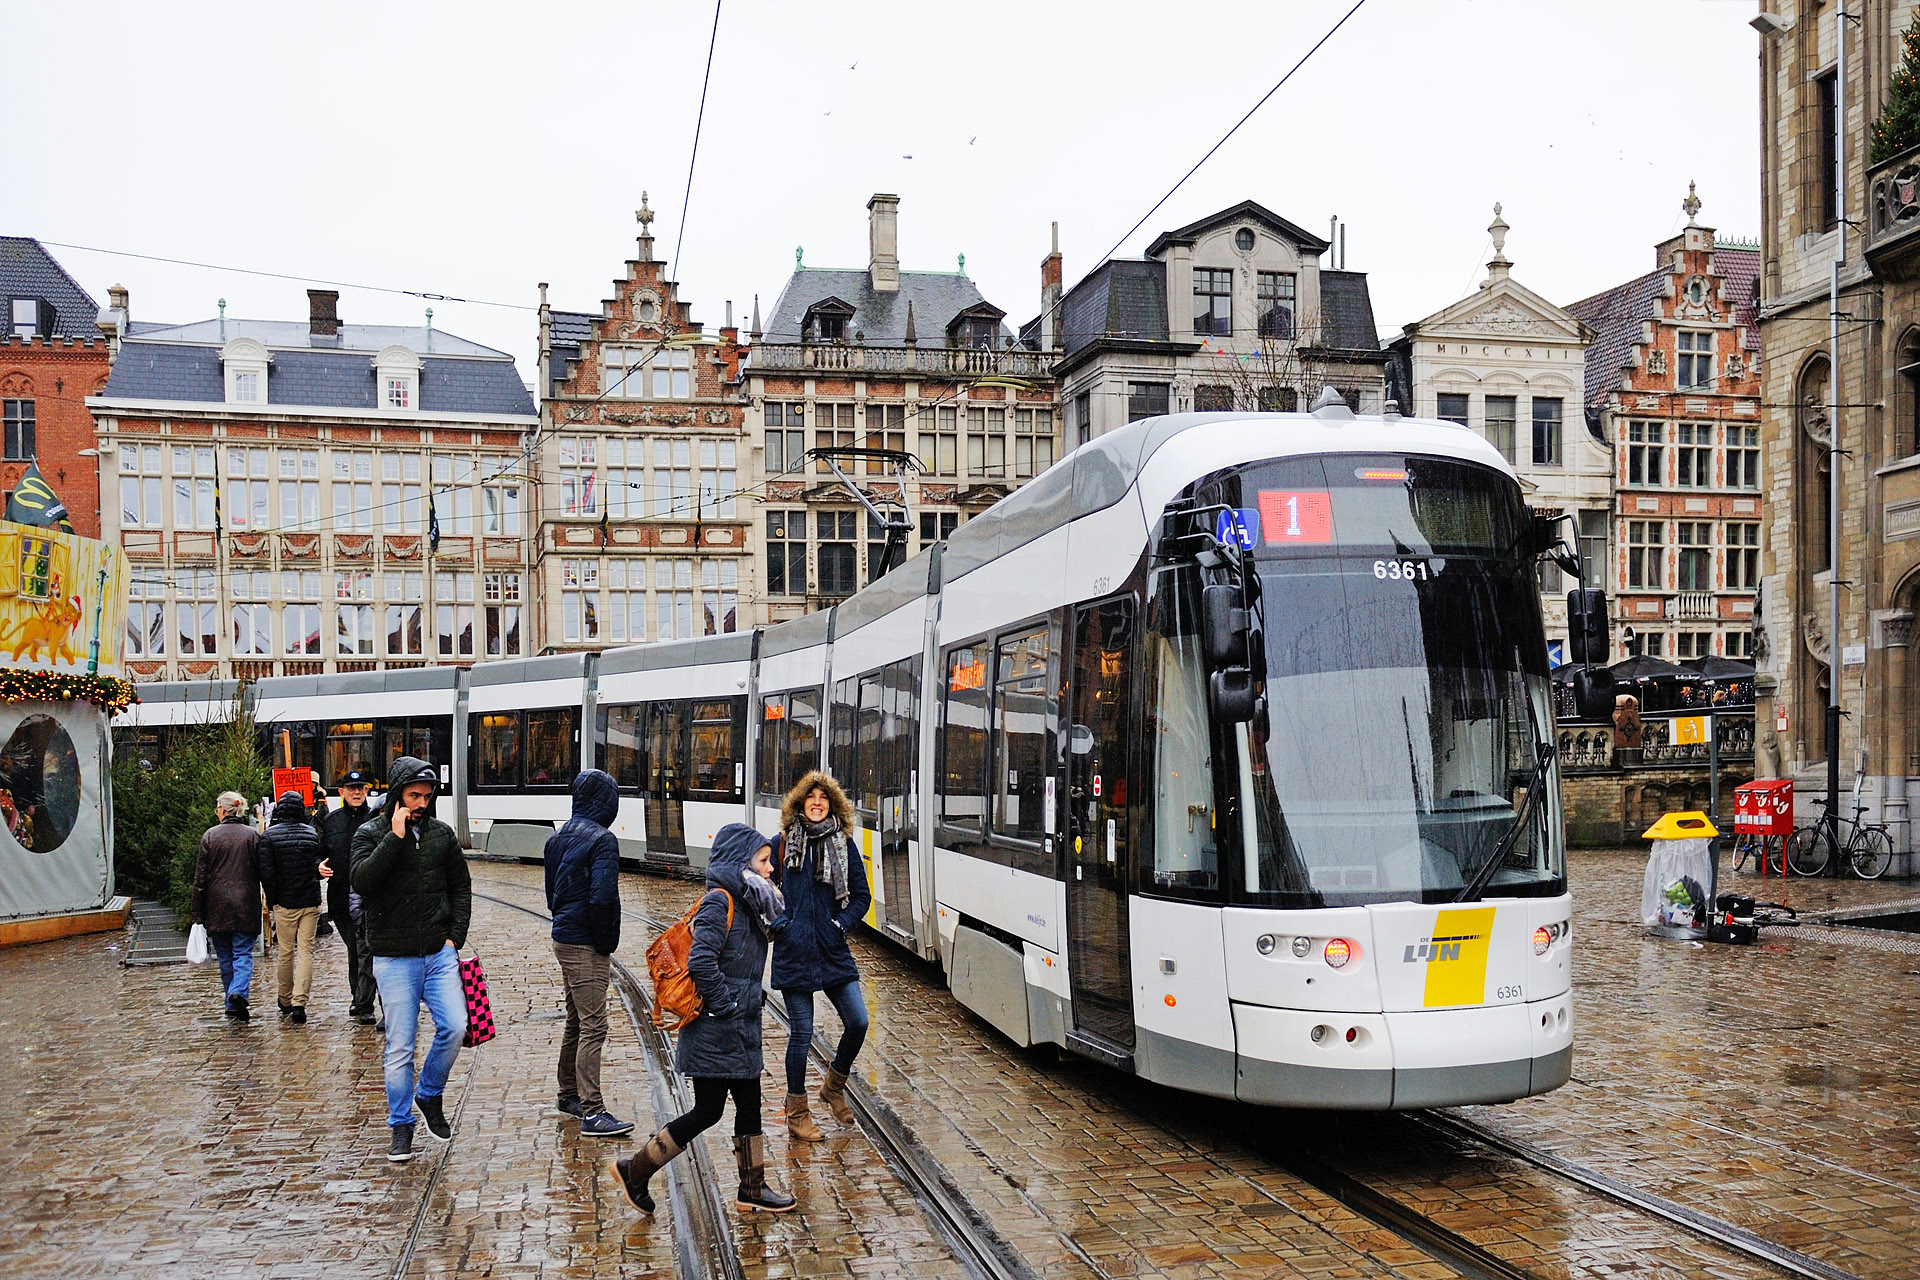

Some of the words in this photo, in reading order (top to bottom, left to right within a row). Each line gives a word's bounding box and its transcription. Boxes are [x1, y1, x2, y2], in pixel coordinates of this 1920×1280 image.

[1286, 495, 1301, 536] 1
[1373, 561, 1427, 581] 6361
[1093, 575, 1110, 596] 6361
[276, 772, 310, 785] OPGEPAST!
[1497, 985, 1523, 999] 6361
